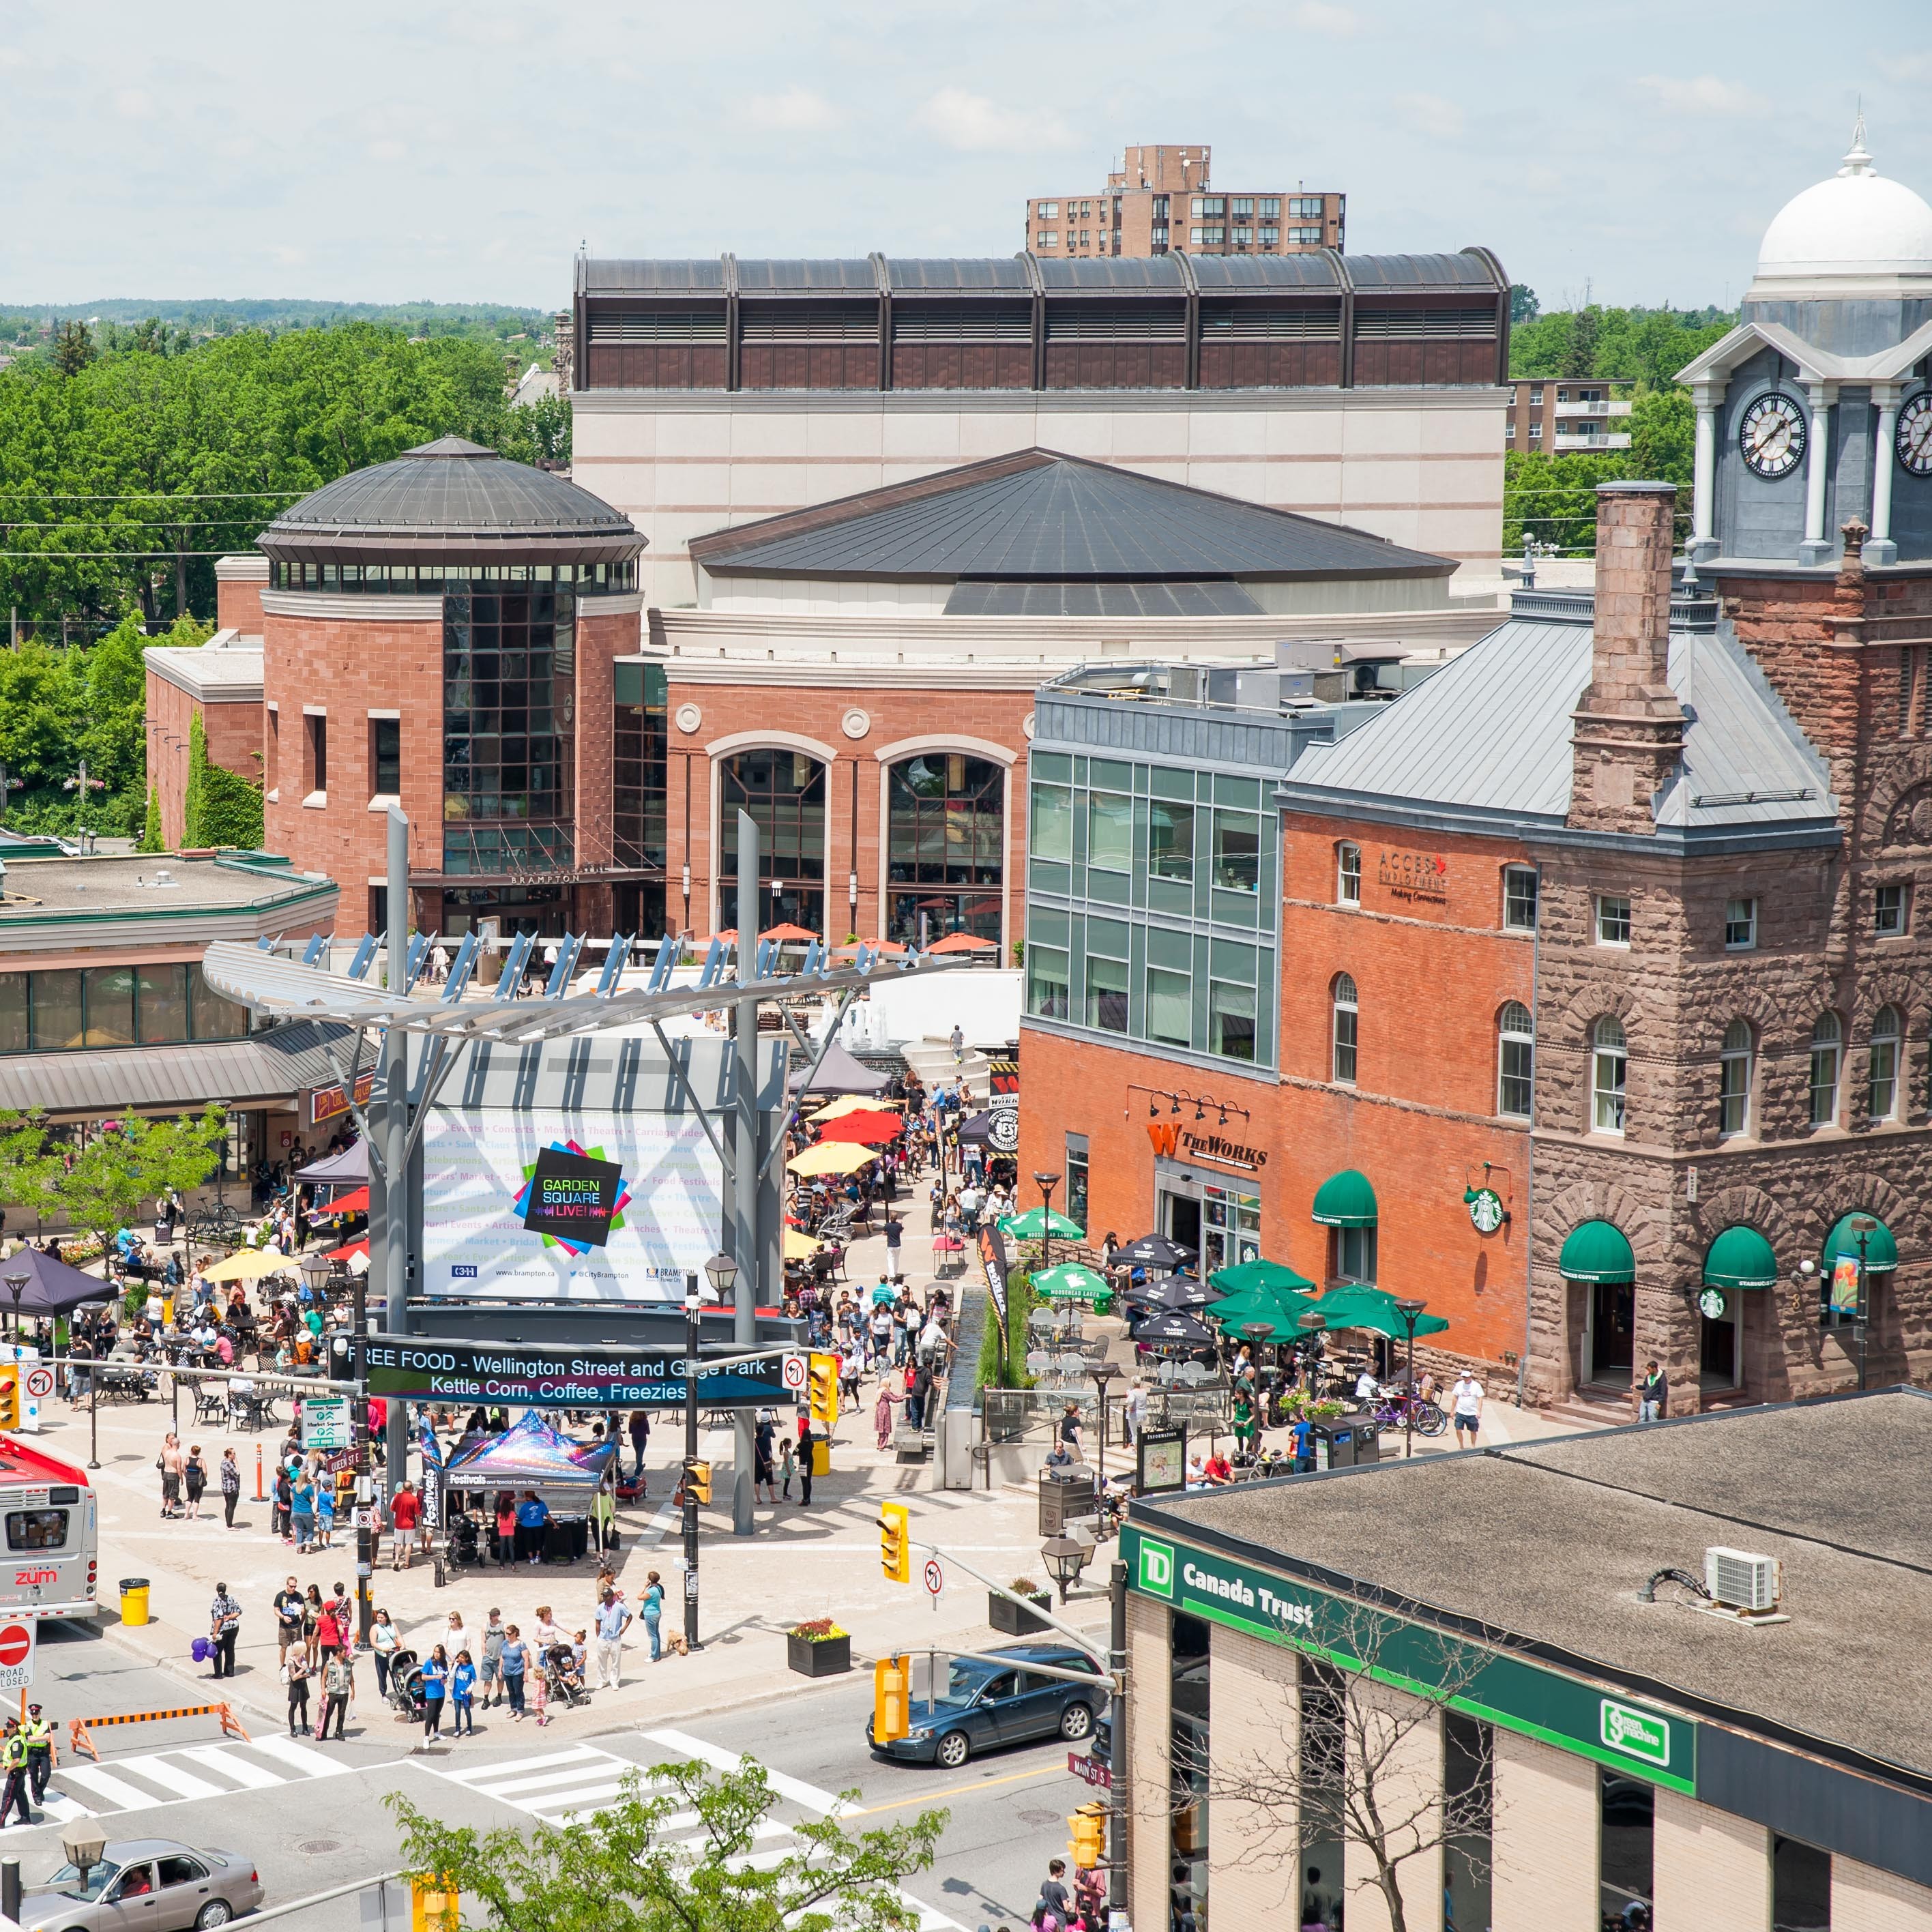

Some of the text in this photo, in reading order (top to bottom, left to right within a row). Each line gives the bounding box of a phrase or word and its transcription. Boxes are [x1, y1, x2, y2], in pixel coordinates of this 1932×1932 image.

[1379, 869, 1446, 891] EMPLOYMENT
[1391, 888, 1411, 904] Making
[995, 1122, 1019, 1136] BEST
[1147, 1122, 1183, 1155] W
[543, 1180, 600, 1191] GARDEN
[543, 1192, 600, 1204] SQUARE
[556, 1205, 587, 1217] LIVE!
[495, 1269, 555, 1278] www.brampton.ca
[579, 1271, 629, 1280] @CityBrampton
[1792, 1293, 1800, 1309] 8
[401, 1351, 455, 1371] FOOD
[473, 1356, 565, 1378] Wellington
[571, 1360, 627, 1376] Street
[630, 1360, 664, 1377] and
[671, 1360, 719, 1379] Gge
[725, 1359, 766, 1375] Park
[431, 1376, 687, 1402] Kettle Corn, Coffee, Freezies
[1147, 1432, 1177, 1440] INFORMATION
[331, 1452, 360, 1472] QUEEN ST E
[450, 1474, 486, 1485] Festivals
[422, 1469, 436, 1527] Festivals
[1143, 1547, 1170, 1585] TD
[15, 1567, 57, 1585] züm
[1183, 1563, 1313, 1628] Canada Trust
[0, 1667, 24, 1678] ROAD
[1, 1675, 29, 1687] LOSED
[1624, 1726, 1660, 1746] machine
[1074, 1760, 1105, 1784] MAIN ST S
